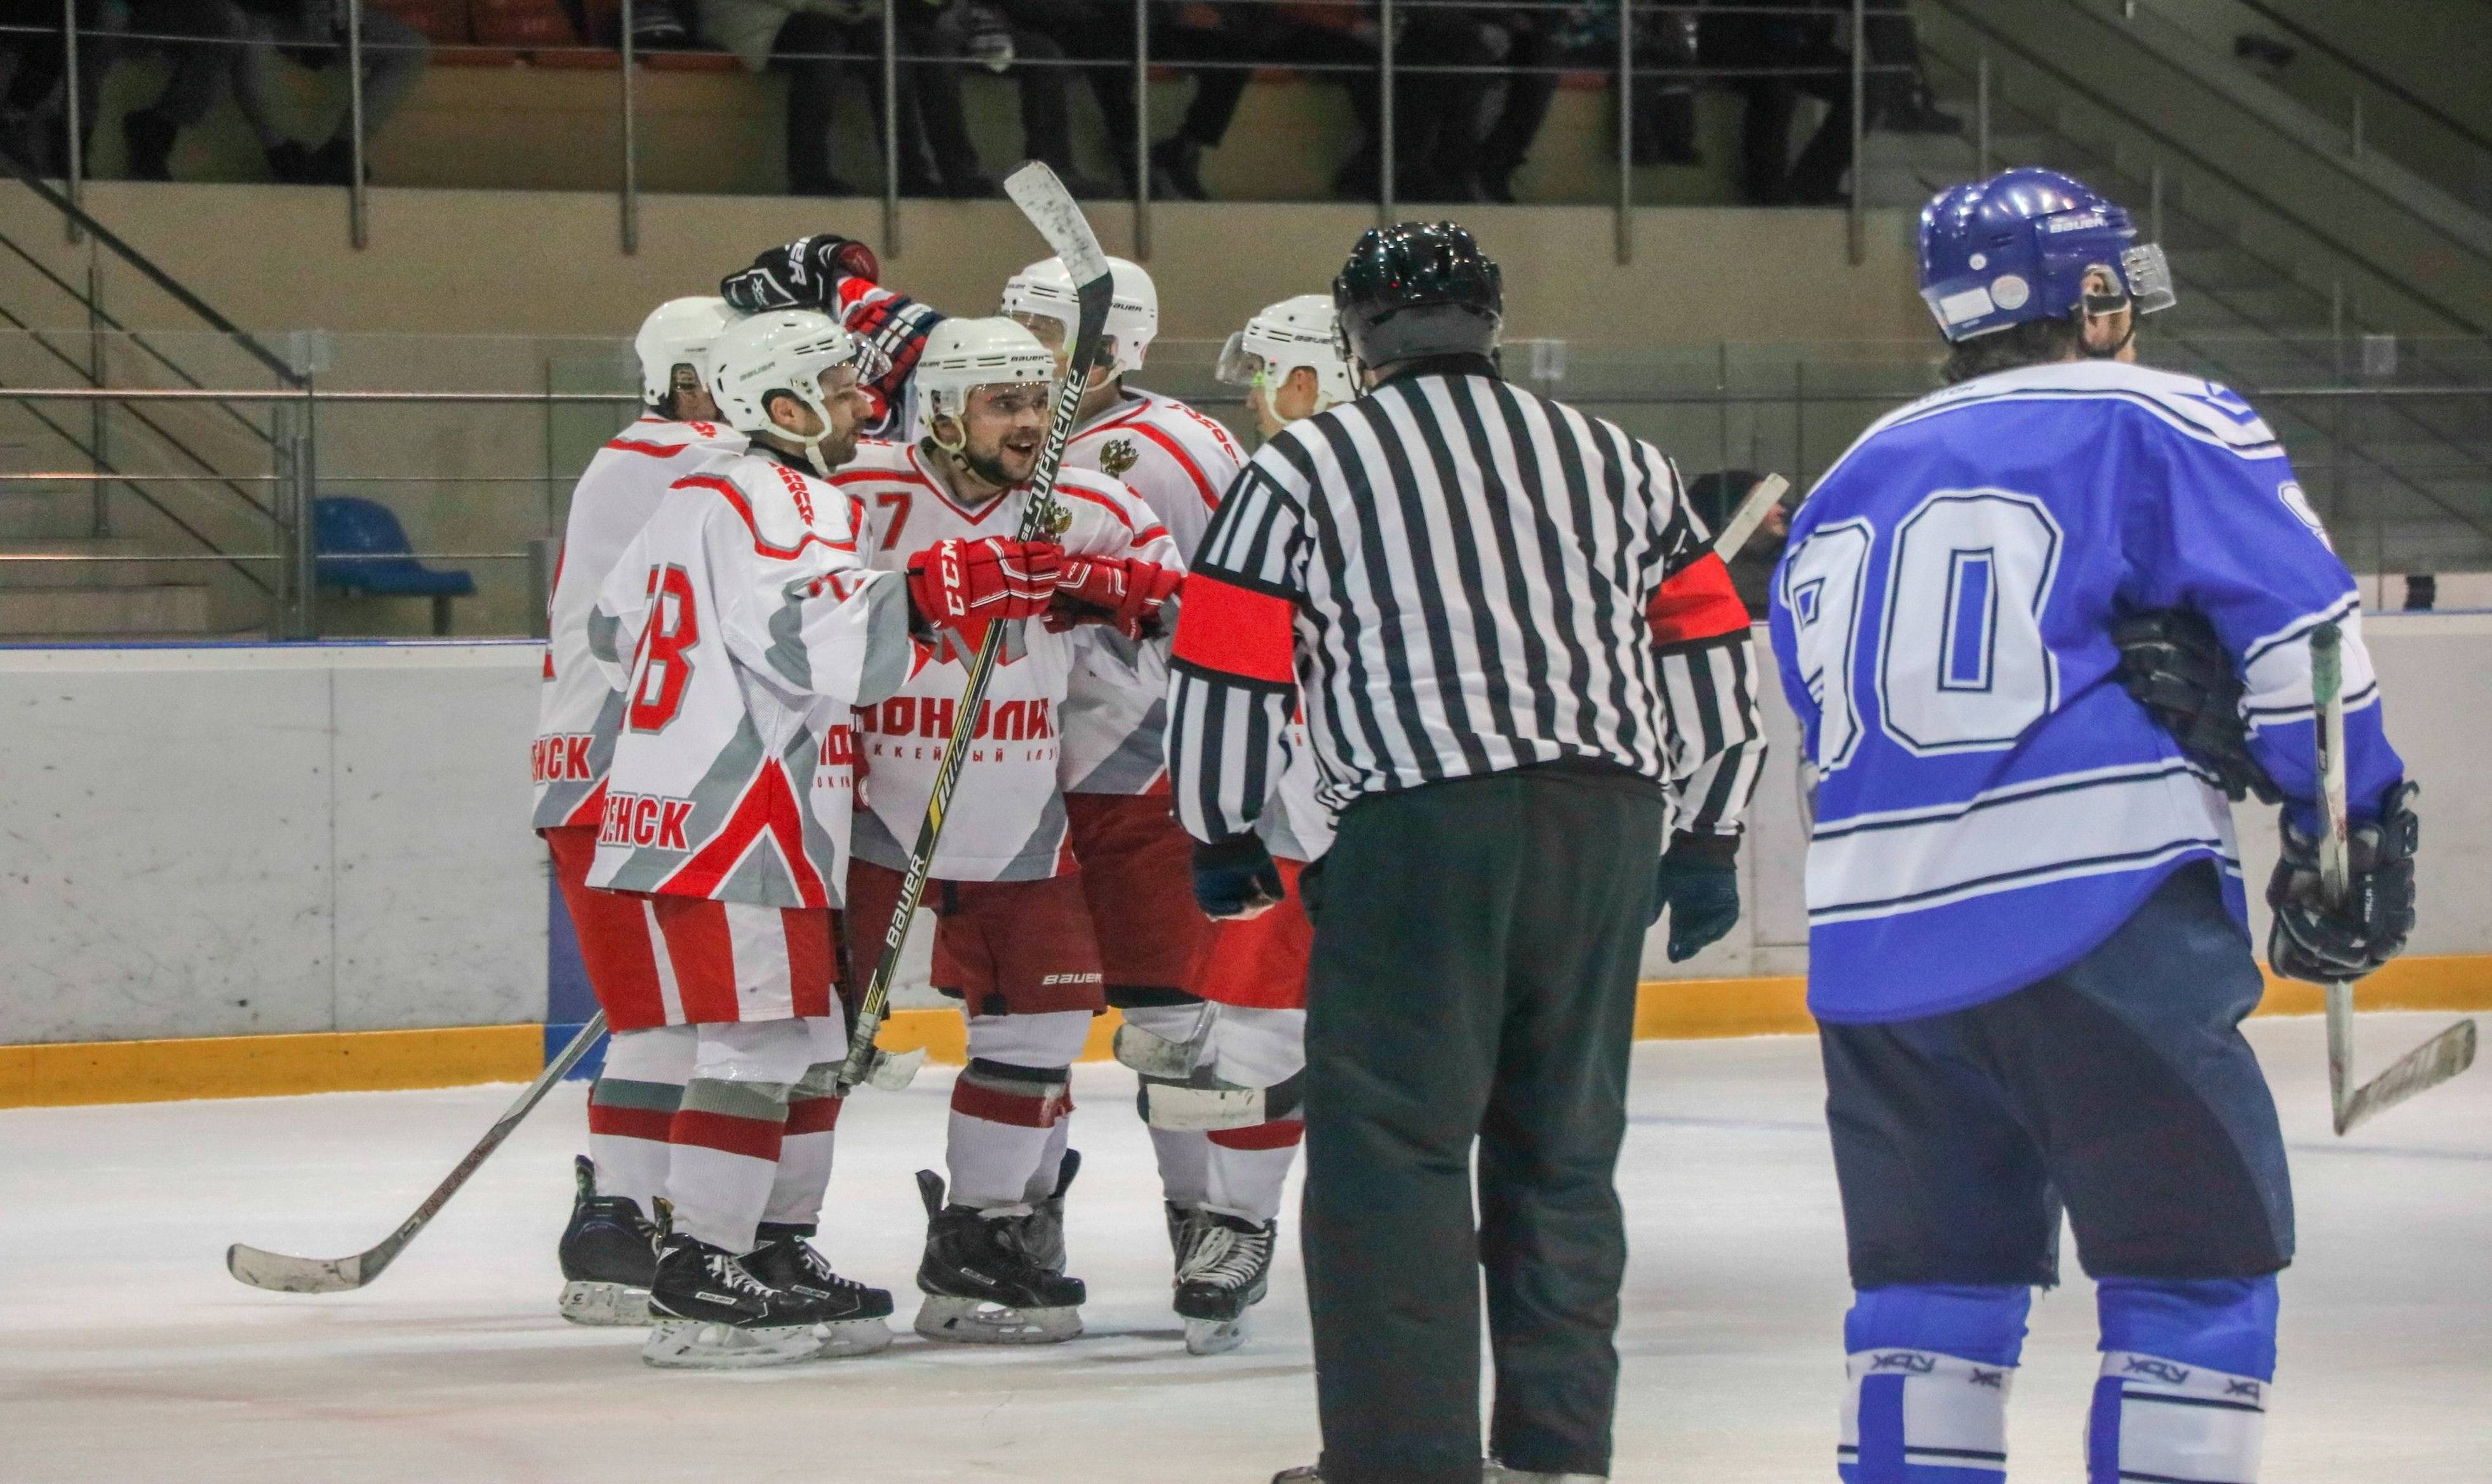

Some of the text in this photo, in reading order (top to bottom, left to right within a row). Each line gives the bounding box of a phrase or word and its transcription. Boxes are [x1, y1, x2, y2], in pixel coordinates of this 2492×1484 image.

[2049, 216, 2106, 233] BAUER
[1111, 303, 1142, 312] AUER
[1026, 369, 1085, 524] SUPREME
[942, 539, 966, 617] CCM
[621, 562, 700, 735] 8
[1780, 486, 2063, 781] 90
[886, 853, 925, 949] BAUER
[1042, 973, 1102, 986] BAUER
